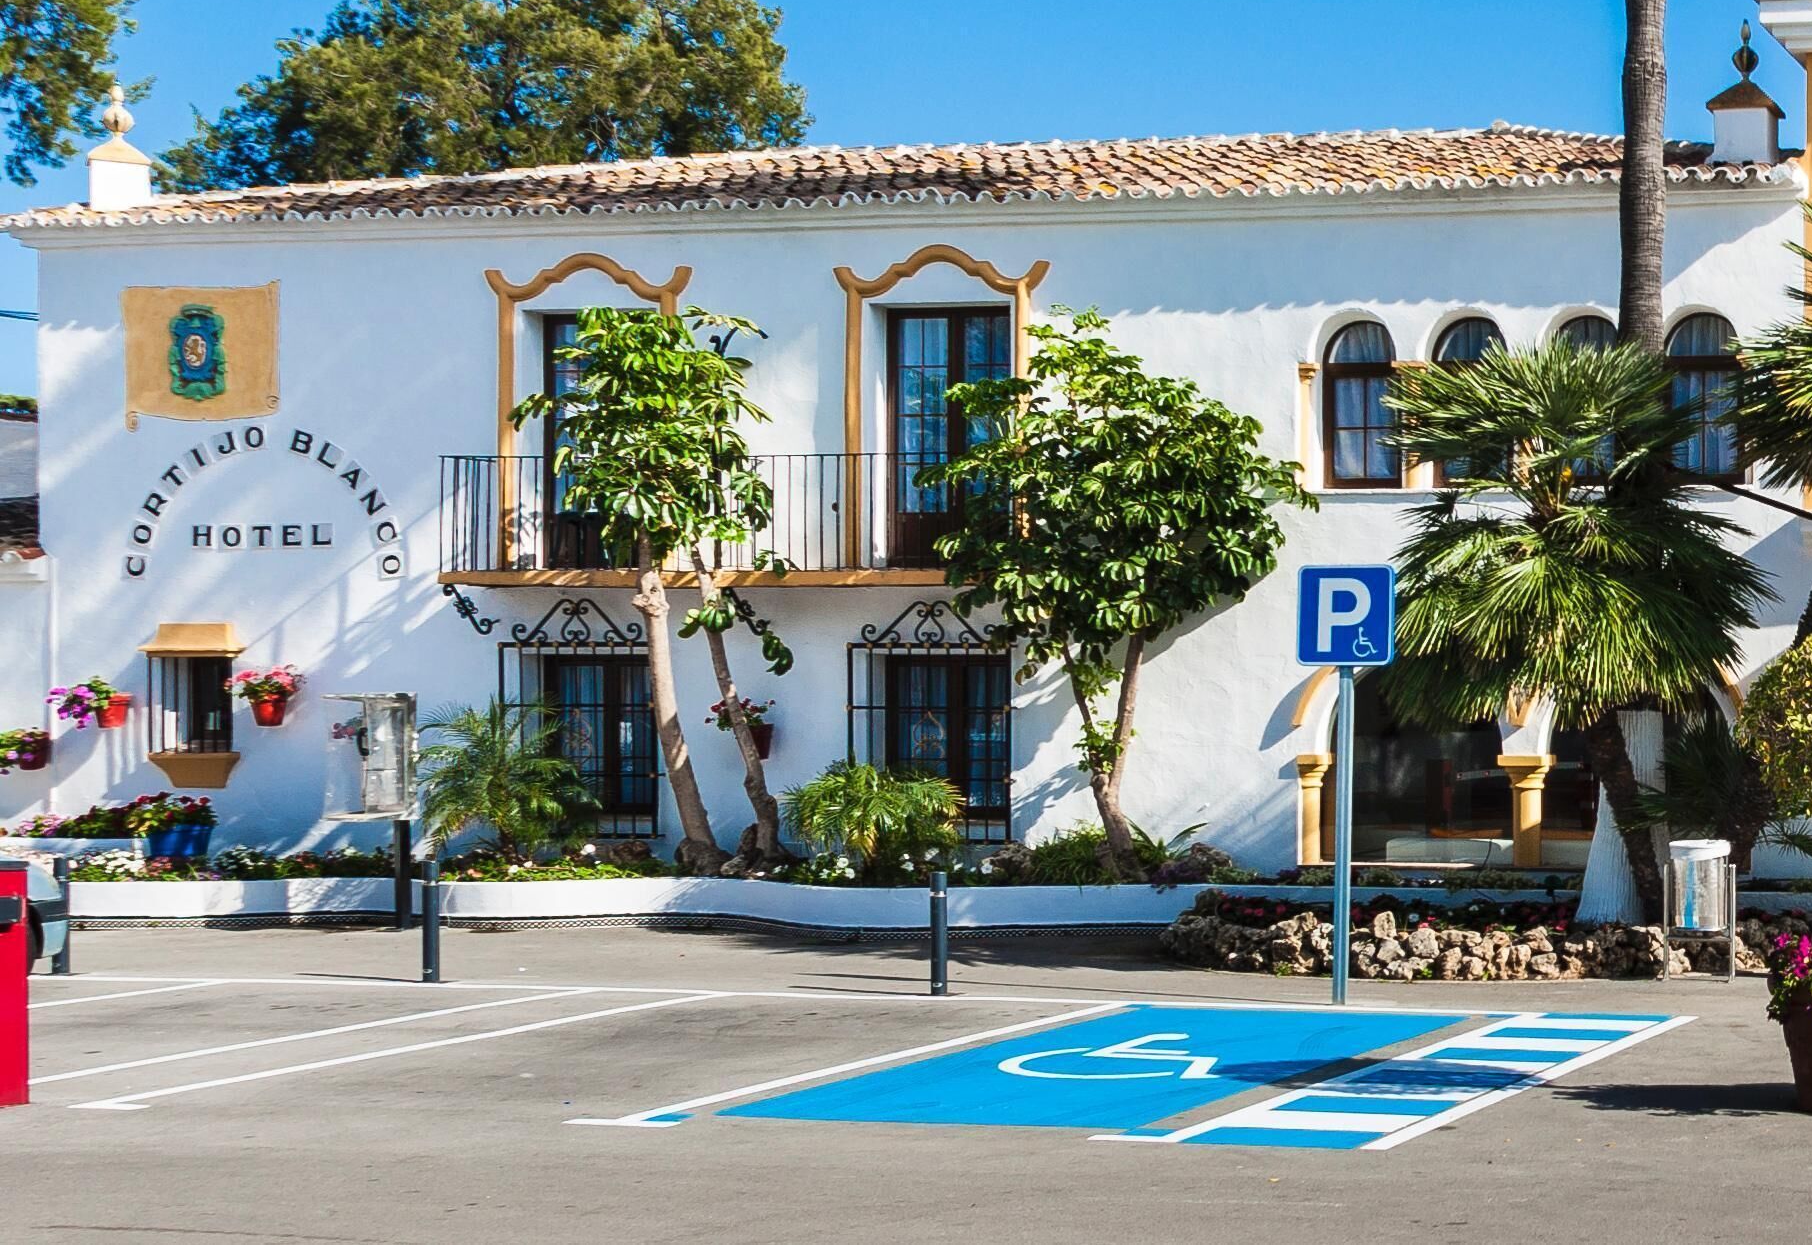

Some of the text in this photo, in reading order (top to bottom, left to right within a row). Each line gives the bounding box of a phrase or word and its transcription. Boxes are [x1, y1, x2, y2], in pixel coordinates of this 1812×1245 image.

[126, 426, 400, 577] CORTIJO BLANCO
[191, 524, 332, 548] HOTEL
[1316, 577, 1372, 653] P
